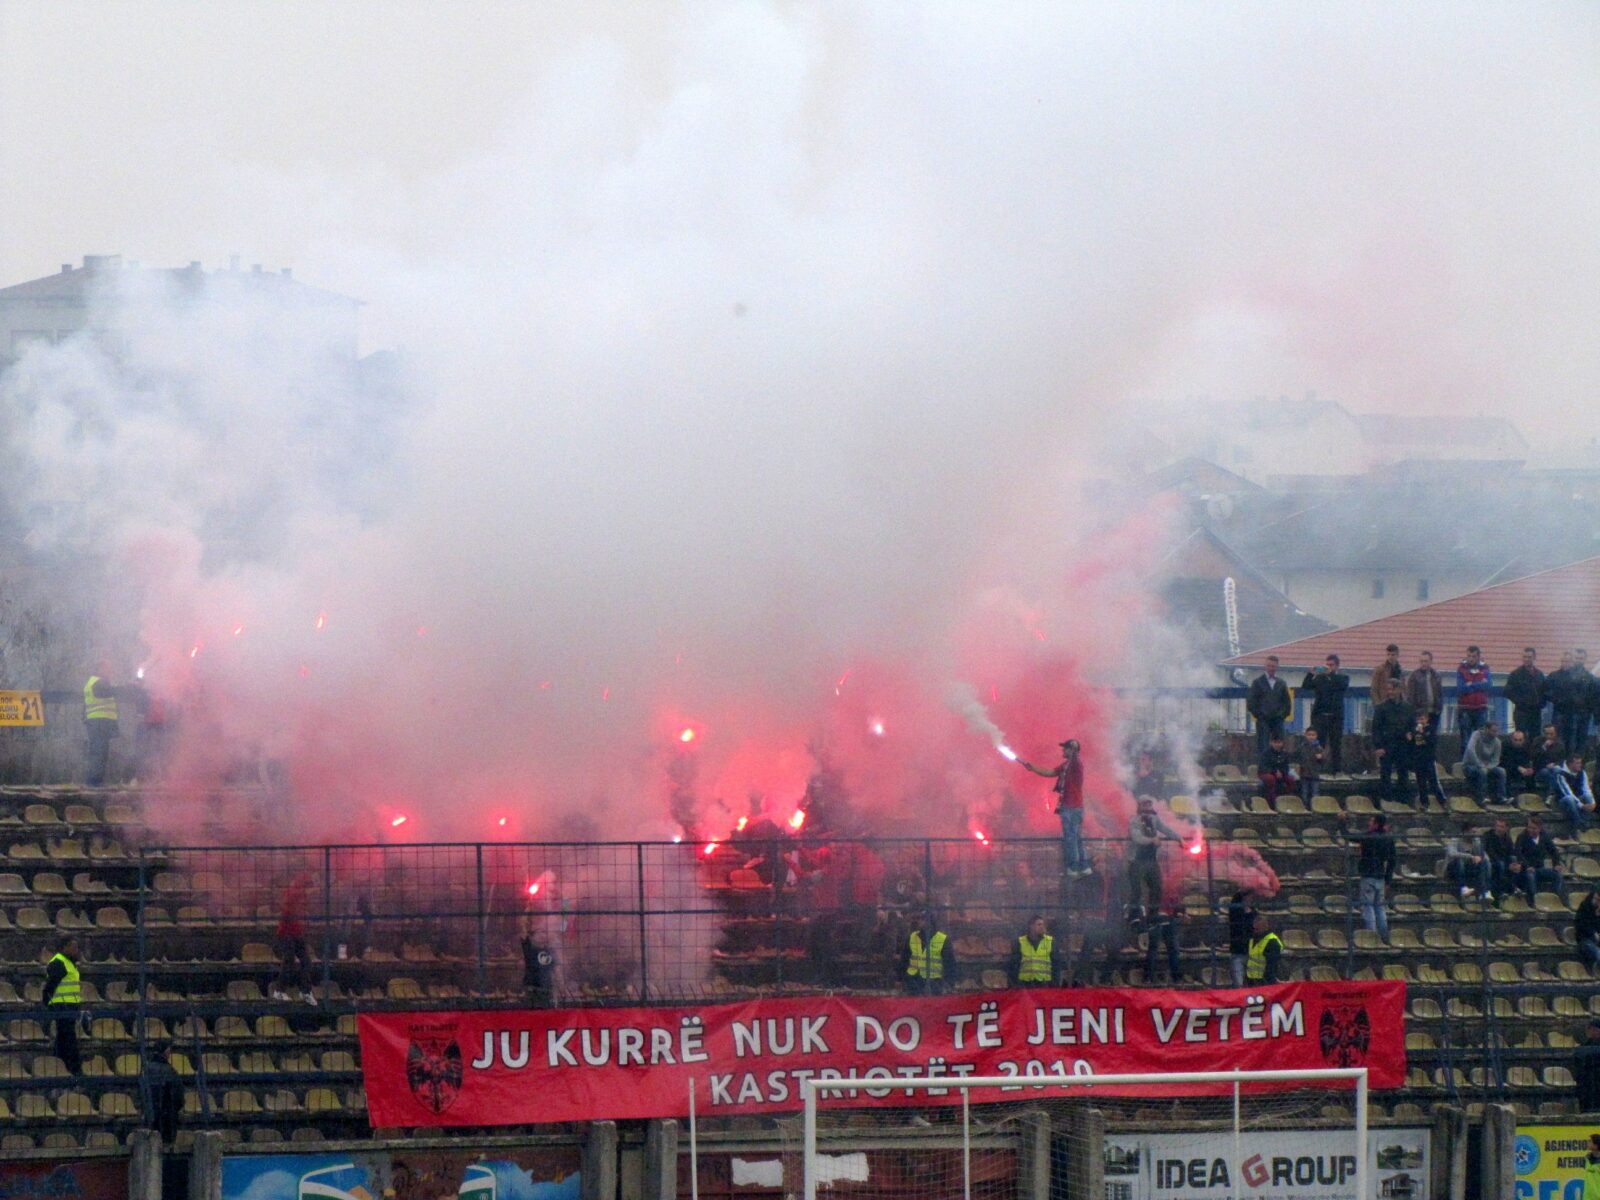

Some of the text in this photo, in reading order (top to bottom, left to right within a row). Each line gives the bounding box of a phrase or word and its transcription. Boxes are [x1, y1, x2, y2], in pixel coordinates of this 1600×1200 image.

[21, 697, 40, 720] 21
[472, 995, 1306, 1069] JU KURRË NUK DO TË JENI VETËM
[709, 1056, 1096, 1106] KASTRIOTËT 2010
[1156, 1153, 1358, 1190] IDEA GROUP
